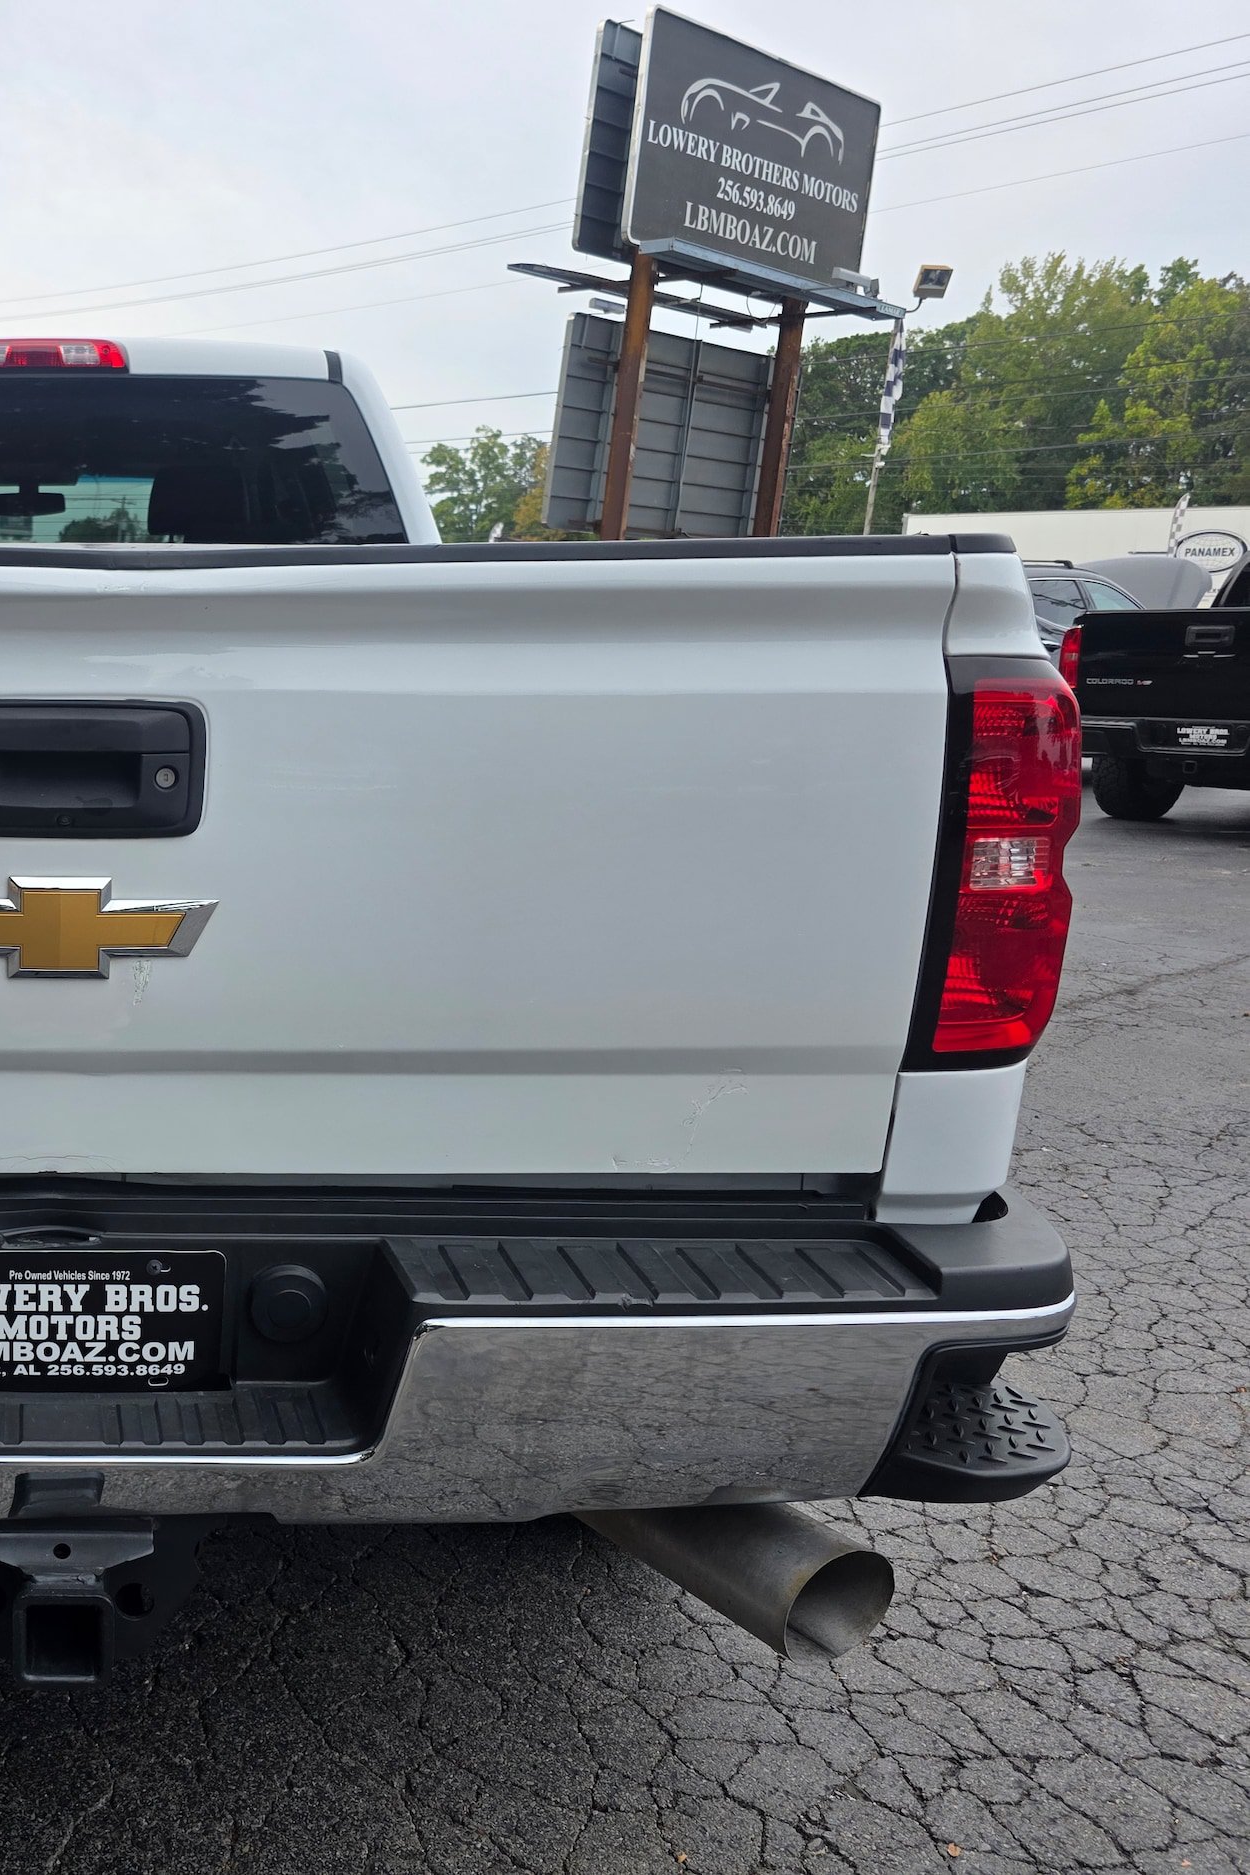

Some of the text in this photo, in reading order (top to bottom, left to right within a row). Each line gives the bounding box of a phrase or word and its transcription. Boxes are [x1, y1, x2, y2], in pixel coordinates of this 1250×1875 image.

[647, 119, 859, 213] LOWERY BROTHERS MOTORS
[716, 177, 796, 221] 256.593.8649
[683, 201, 818, 265] LBMBOAZ.COM
[1184, 547, 1236, 557] PANAMEX
[1086, 678, 1134, 686] COLORADO
[9, 1271, 131, 1281] Pre Owned Vehicles Since 1972
[104, 1284, 209, 1313] BROS.
[13, 1364, 41, 1376] AL
[47, 1363, 186, 1376] 256.593.8649
